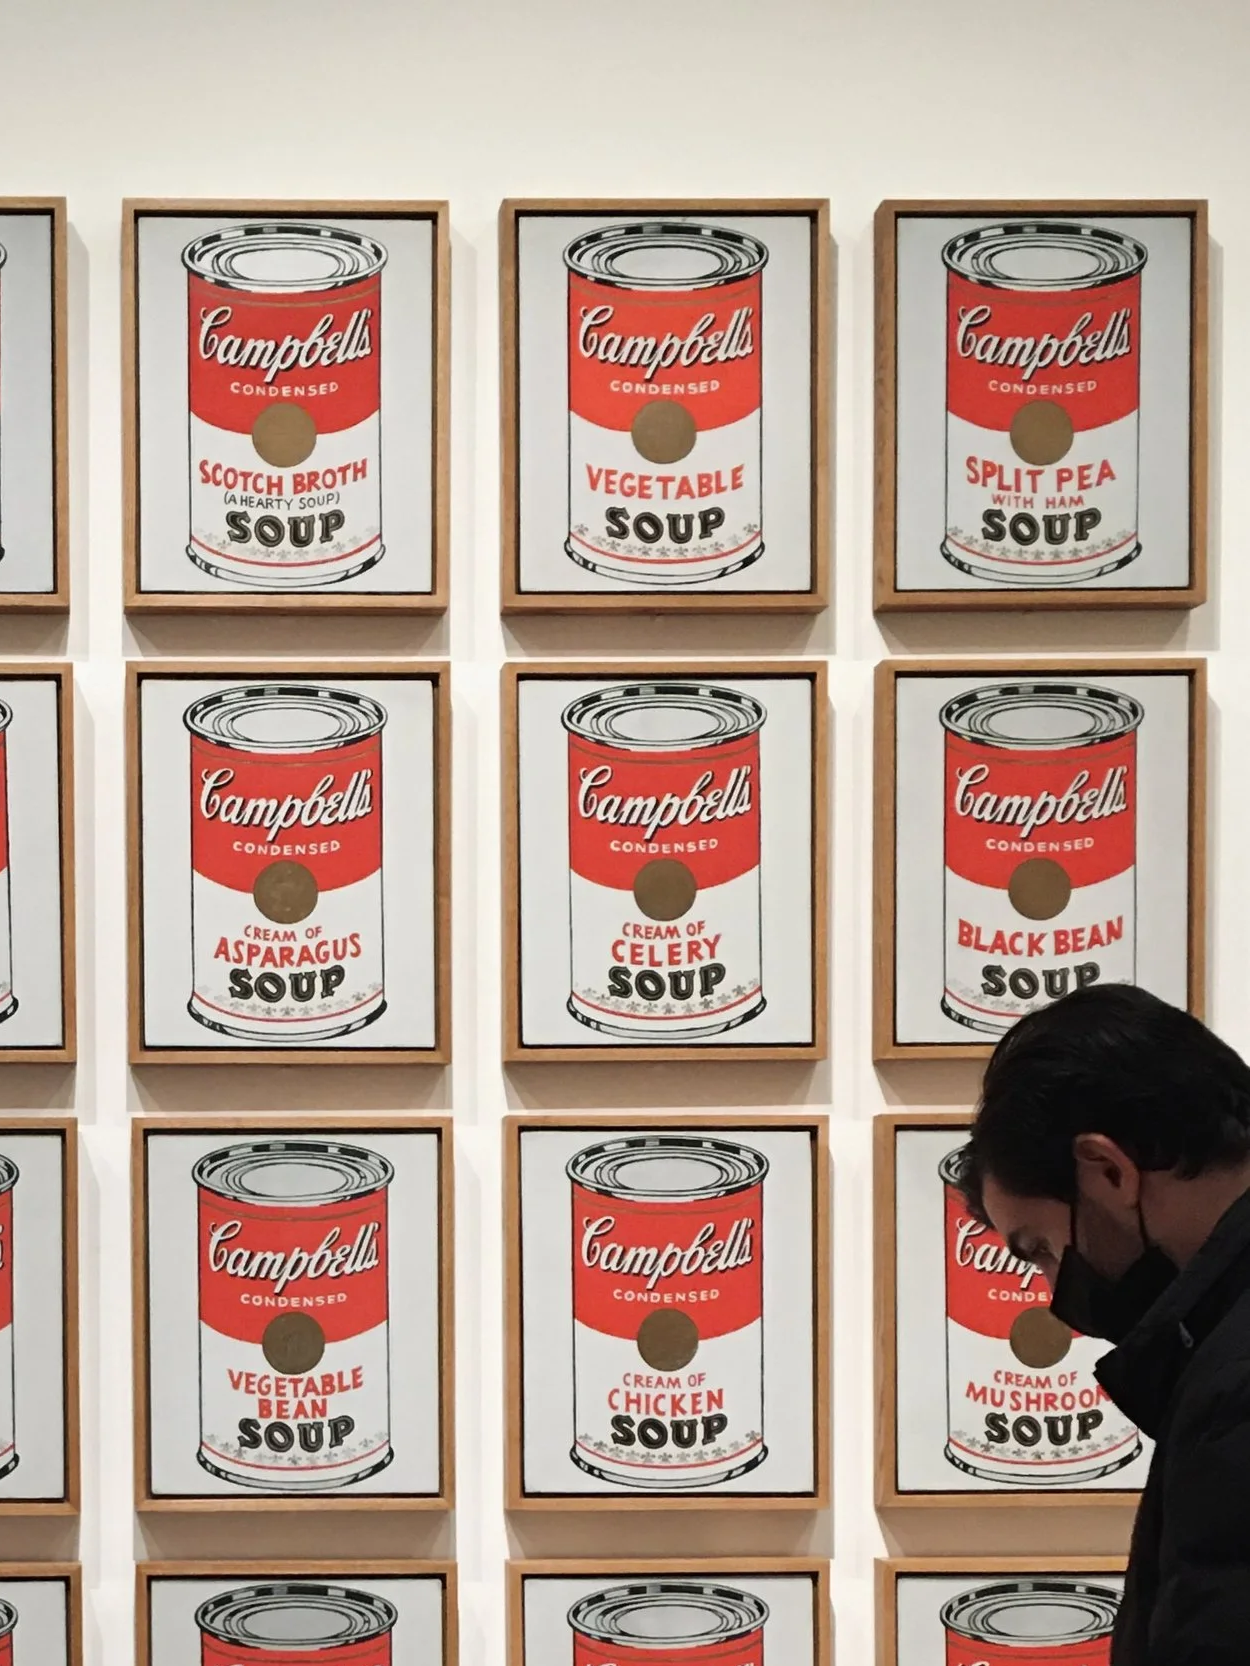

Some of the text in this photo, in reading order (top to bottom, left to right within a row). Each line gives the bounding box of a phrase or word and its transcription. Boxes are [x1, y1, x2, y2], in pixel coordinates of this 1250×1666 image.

[231, 382, 337, 396] CONDENSED
[611, 380, 719, 394] CONDENSED
[990, 381, 1096, 394] CONDENSED
[200, 459, 367, 495] SCOTCH BROTH
[587, 465, 743, 499] VEGETABLE
[966, 456, 1114, 492] SPLIT PEA
[224, 491, 340, 510] (A HEARTY SOUP)
[992, 494, 1084, 508] WITH HAM
[226, 510, 344, 547] SOUP
[606, 507, 724, 544] SOUP
[982, 508, 1101, 546] SOUP
[233, 840, 340, 856] CONDENSED
[610, 839, 717, 853] CONDENSED
[986, 838, 1093, 852] CONDENSED
[245, 926, 322, 941] CREAM OF
[623, 920, 705, 939] CREAM OF
[958, 917, 1122, 957] BLACK BEAN
[215, 929, 361, 968] ASPARAGUS
[611, 935, 719, 967] CELERY
[229, 965, 344, 1002] SOUP
[608, 963, 725, 1001] SOUP
[980, 961, 1101, 999] SOUP
[241, 1293, 346, 1307] CONDENSED
[614, 1289, 718, 1303] CONDENSED
[988, 1288, 1053, 1302] CONDE
[229, 1367, 362, 1397] VEGETABLE
[623, 1373, 704, 1388] CREAM OF
[994, 1371, 1077, 1389] CREAM OF
[258, 1398, 327, 1419] BEAN
[608, 1389, 723, 1417] CHICKEN
[238, 1416, 354, 1452] SOUP
[611, 1414, 727, 1449] SOUP
[985, 1410, 1103, 1447] SOUP
